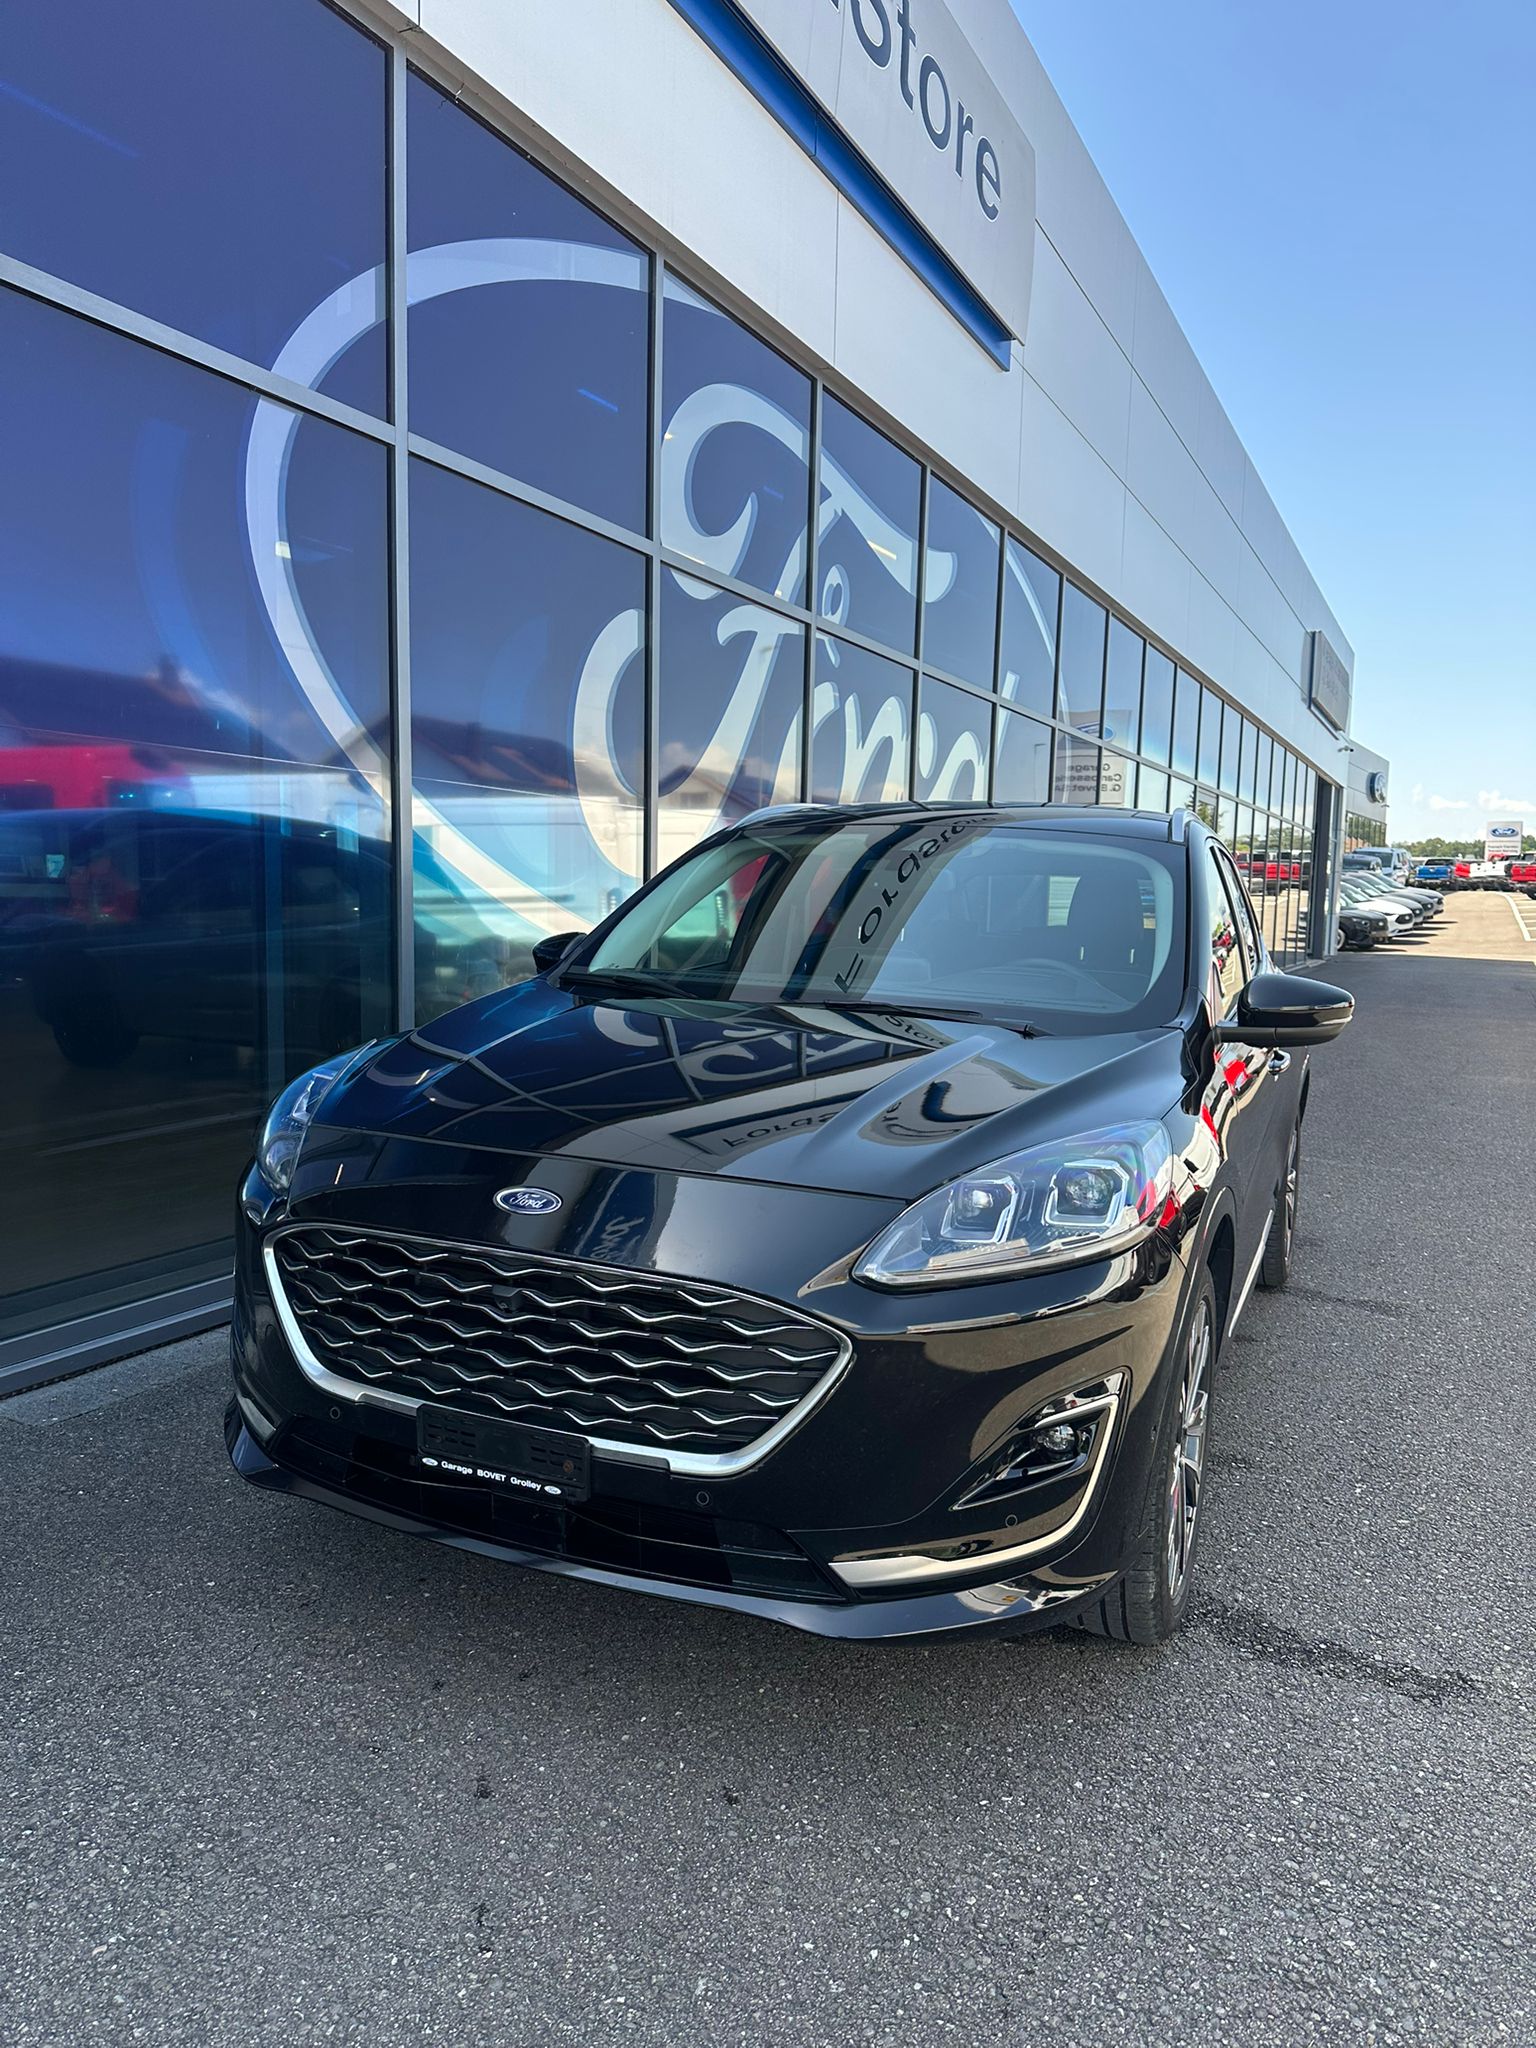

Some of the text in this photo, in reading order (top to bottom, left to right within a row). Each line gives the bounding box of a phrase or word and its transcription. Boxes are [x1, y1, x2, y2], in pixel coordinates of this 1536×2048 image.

[441, 1461, 473, 1475] Garage
[477, 1469, 506, 1482] BOVET
[510, 1476, 541, 1491] Grolley
